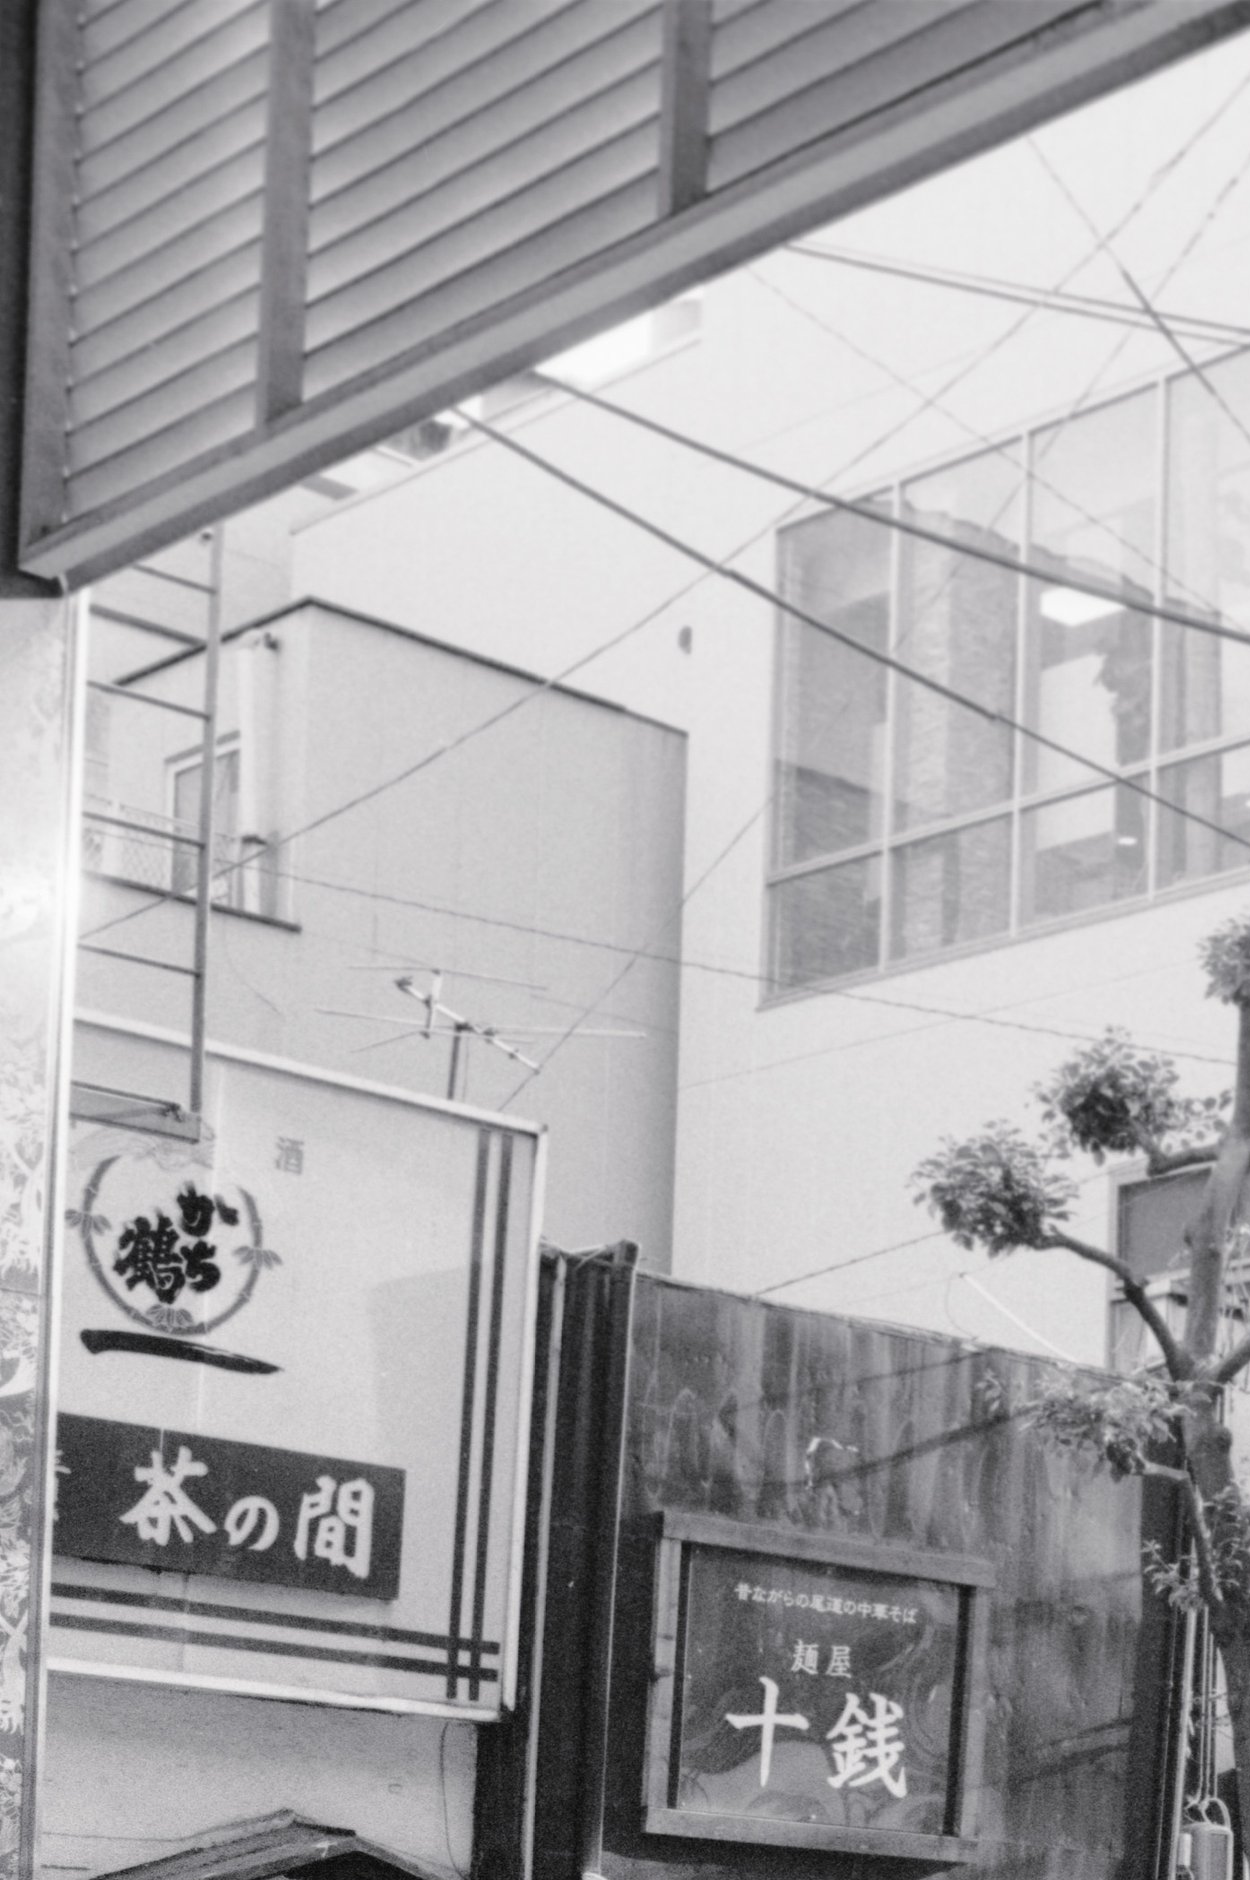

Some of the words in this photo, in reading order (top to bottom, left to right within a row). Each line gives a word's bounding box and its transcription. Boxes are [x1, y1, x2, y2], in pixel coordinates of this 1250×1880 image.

[275, 1137, 305, 1174] 酒
[54, 1445, 376, 1580] 茶の間
[725, 1676, 907, 1798] 十銭
